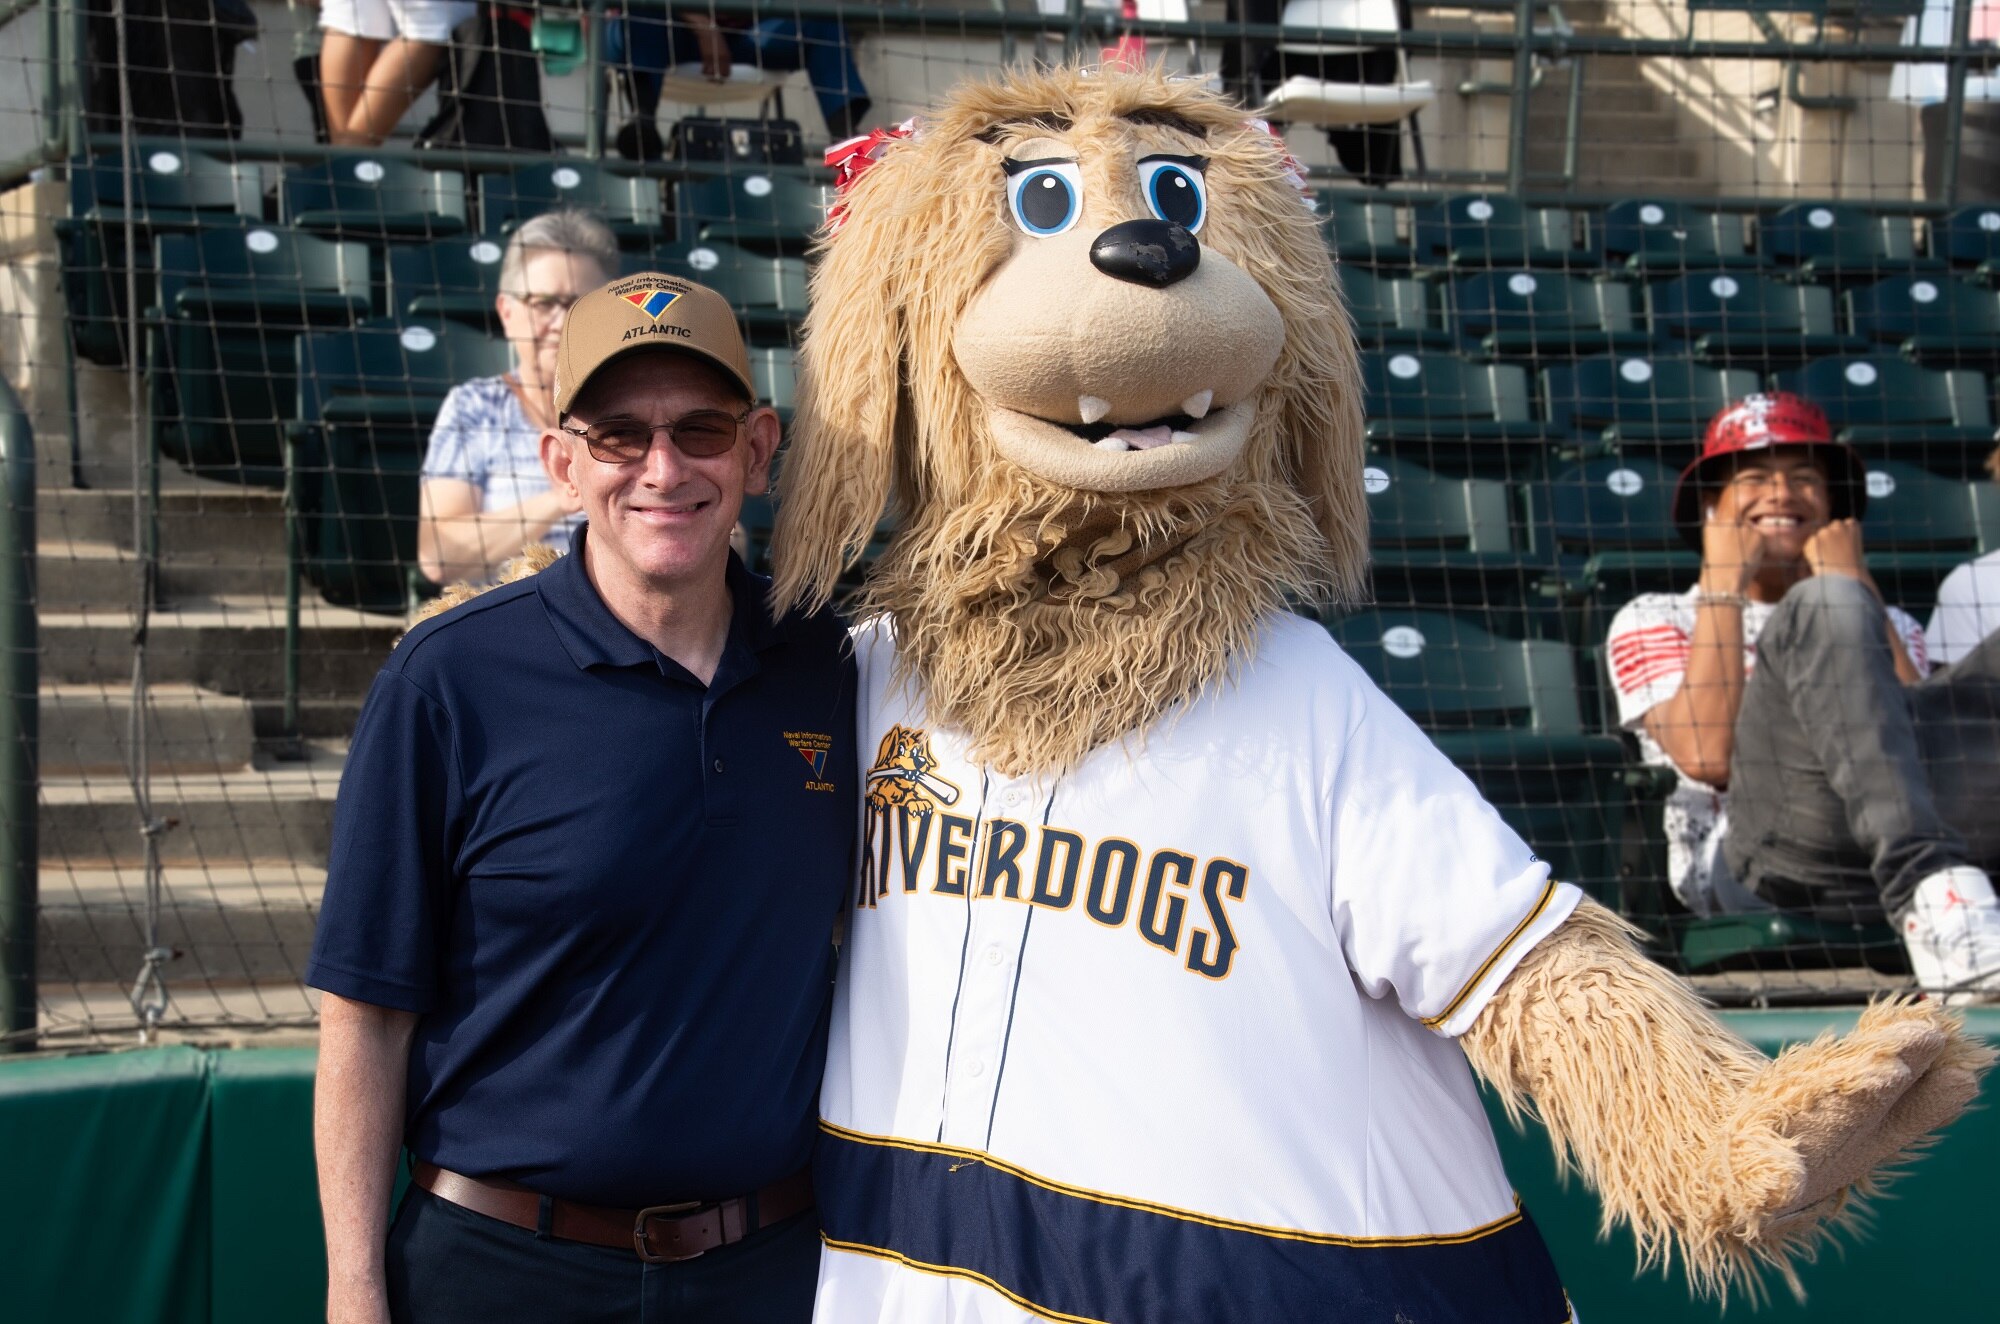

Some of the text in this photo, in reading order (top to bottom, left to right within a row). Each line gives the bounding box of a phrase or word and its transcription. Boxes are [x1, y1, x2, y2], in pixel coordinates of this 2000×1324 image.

[608, 277, 693, 294] Naval Information
[615, 283, 688, 296] Warfare Center
[622, 324, 691, 341] ATLANTIC
[783, 731, 832, 741] Naval Information
[789, 739, 831, 748] Warfare Center
[805, 781, 835, 792] ATLANTIC
[857, 794, 1249, 981] RIVERDOGS
